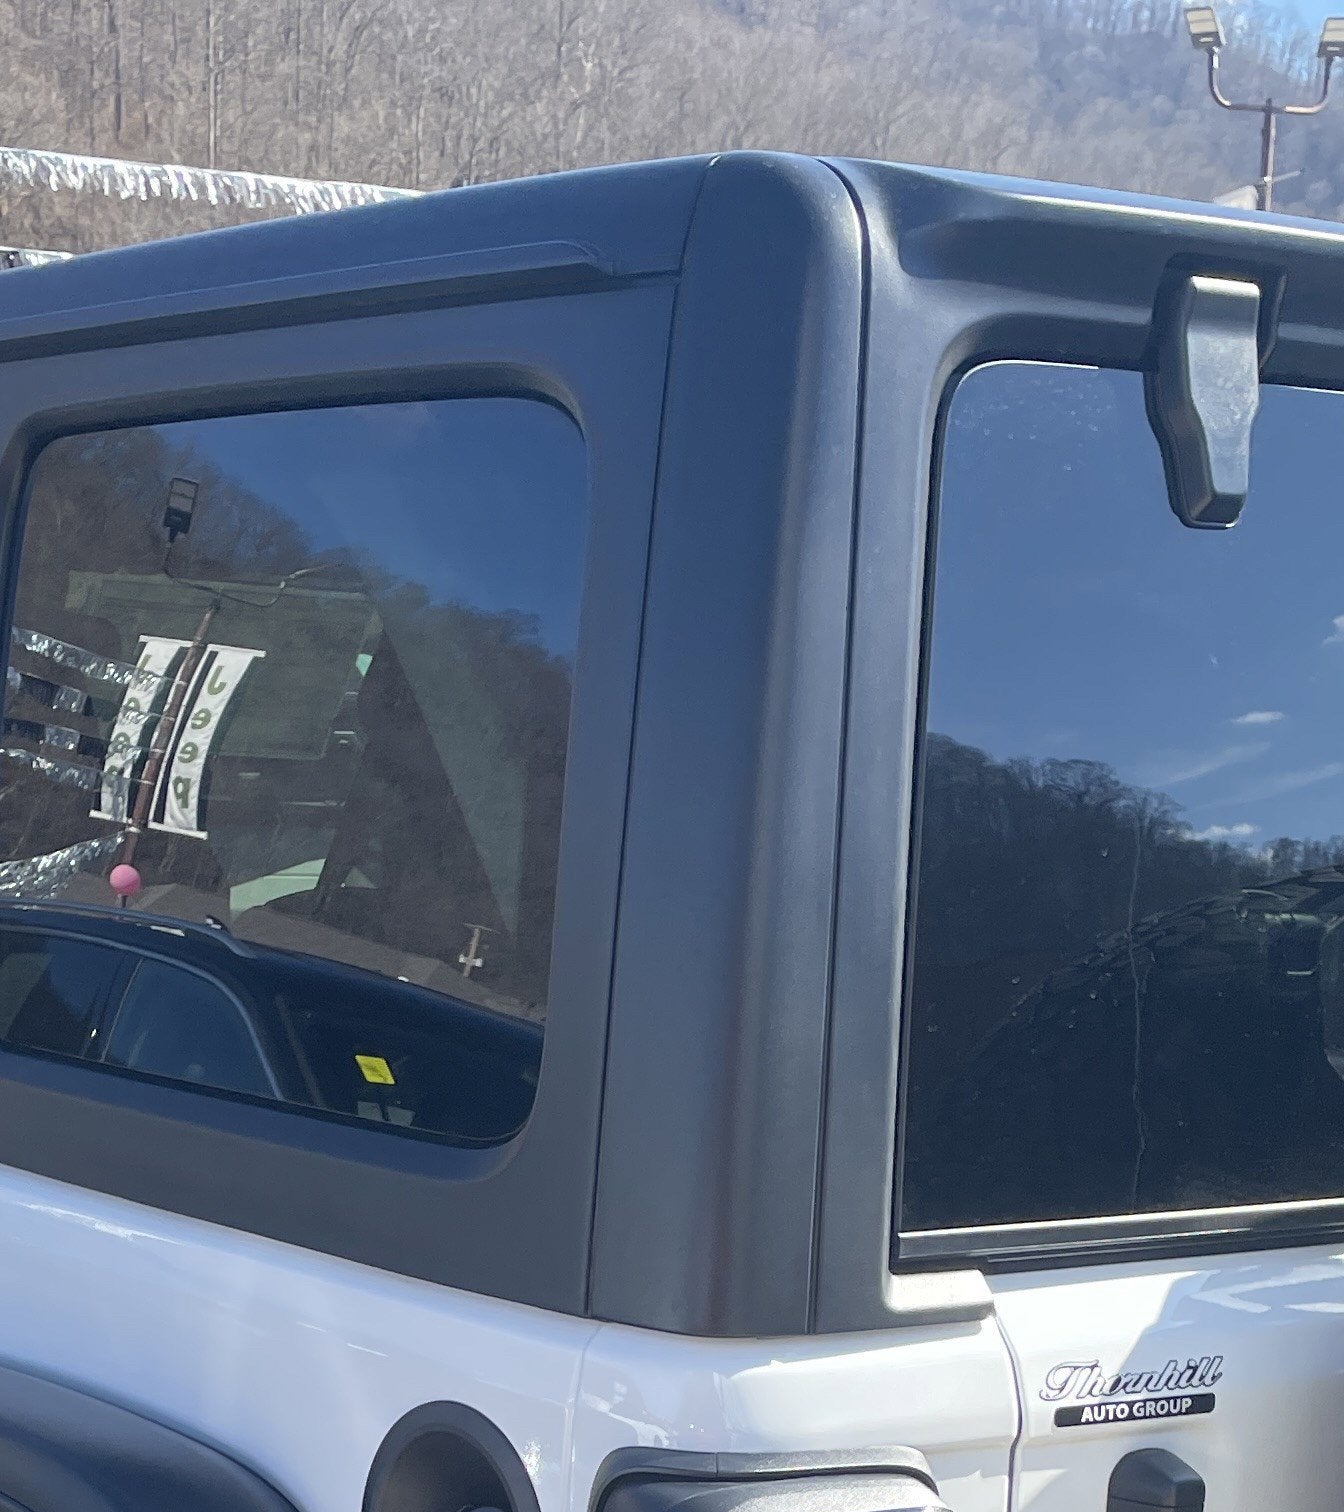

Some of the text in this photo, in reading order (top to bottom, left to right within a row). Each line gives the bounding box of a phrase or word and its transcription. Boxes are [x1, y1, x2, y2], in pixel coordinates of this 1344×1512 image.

[1039, 1355, 1224, 1402] Thornhill
[1080, 1397, 1193, 1424] AUTO GROUP
